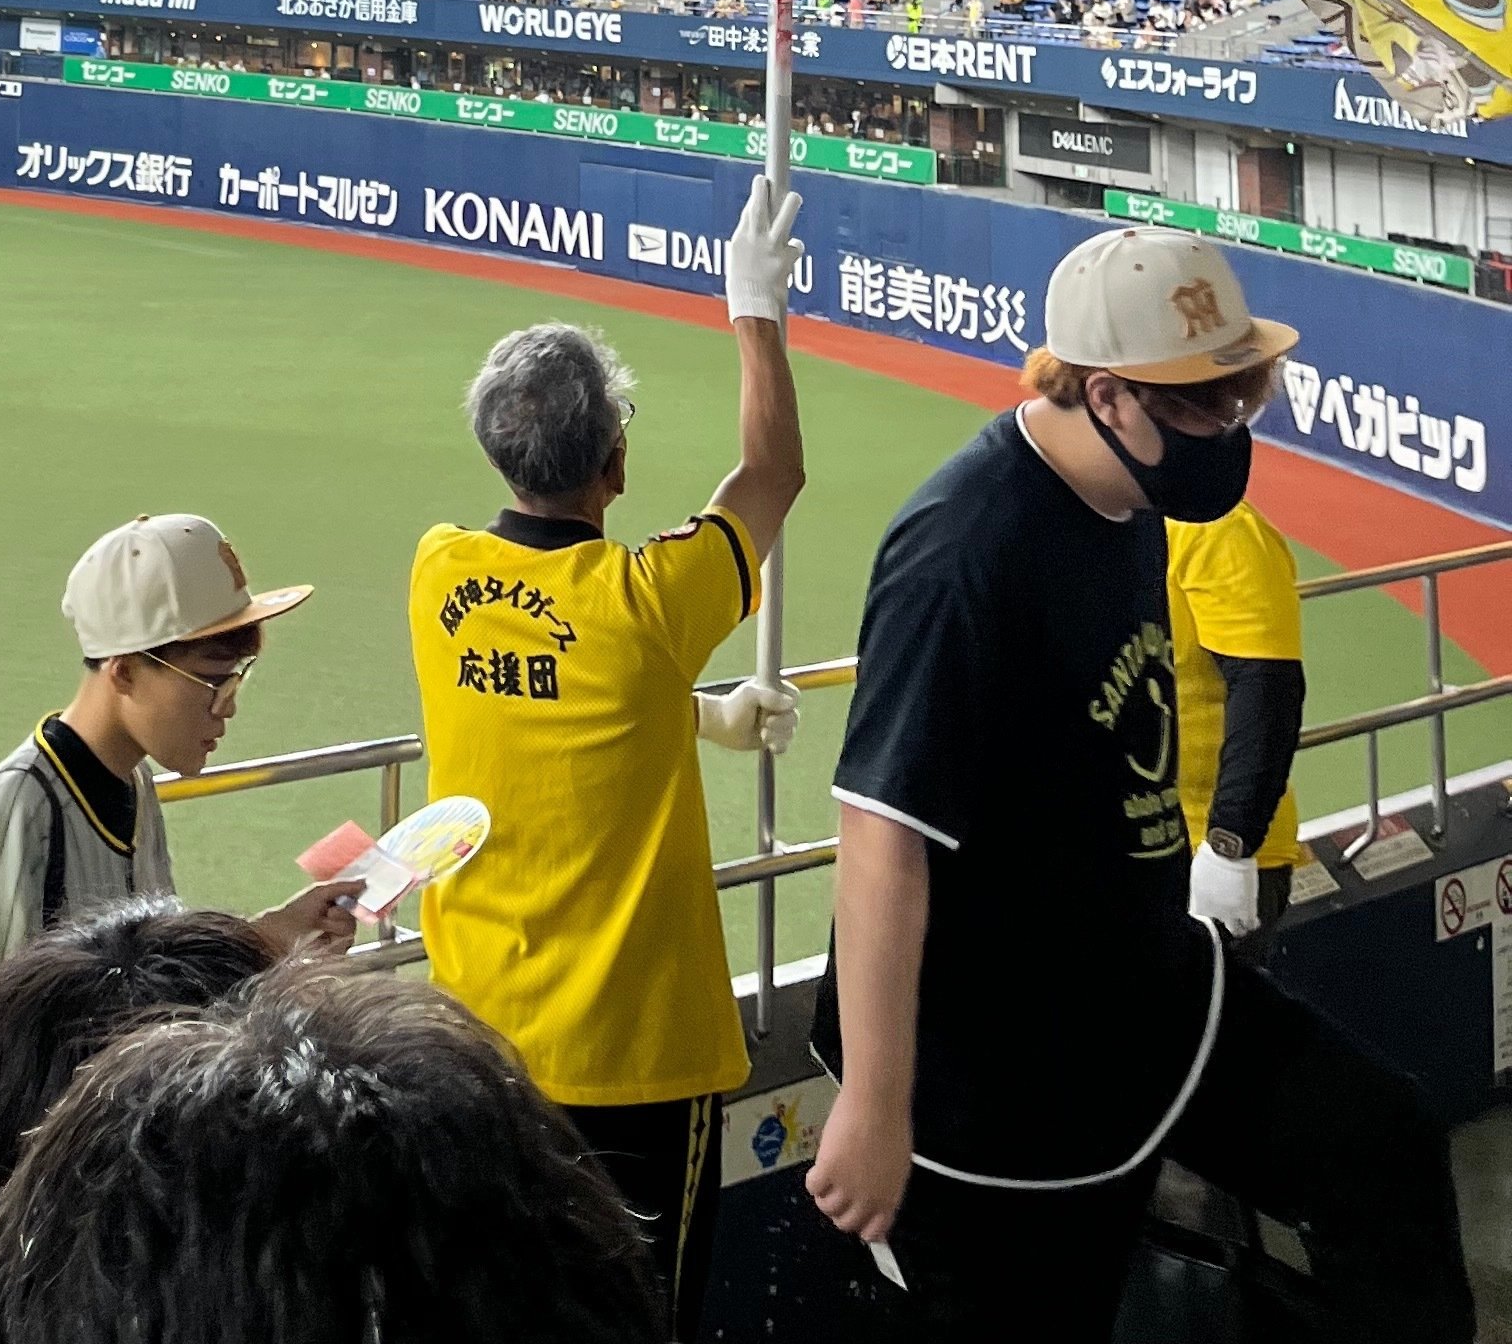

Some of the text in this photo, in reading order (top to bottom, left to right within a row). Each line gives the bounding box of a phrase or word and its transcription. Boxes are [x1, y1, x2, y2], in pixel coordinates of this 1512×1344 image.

[80, 60, 136, 84] センコー
[170, 70, 230, 95] SENKO
[267, 77, 329, 102] センコー
[364, 87, 422, 114] SENKO
[455, 96, 515, 123] センコー
[553, 107, 619, 137] SENKO
[654, 118, 710, 147] センコー
[845, 142, 913, 176] センコー
[1118, 57, 1258, 105] エスフォーライフ
[16, 141, 193, 197] オリックス銀行
[219, 162, 399, 227] カーポートマルゼン
[424, 187, 605, 261] KONAMI
[1126, 193, 1448, 281] センコー SENKO センコー SENKO
[838, 254, 1029, 353] 能美防災
[1319, 374, 1487, 493] ベガビック
[439, 575, 577, 653] 阪神タイガース
[457, 647, 559, 701] 応援団
